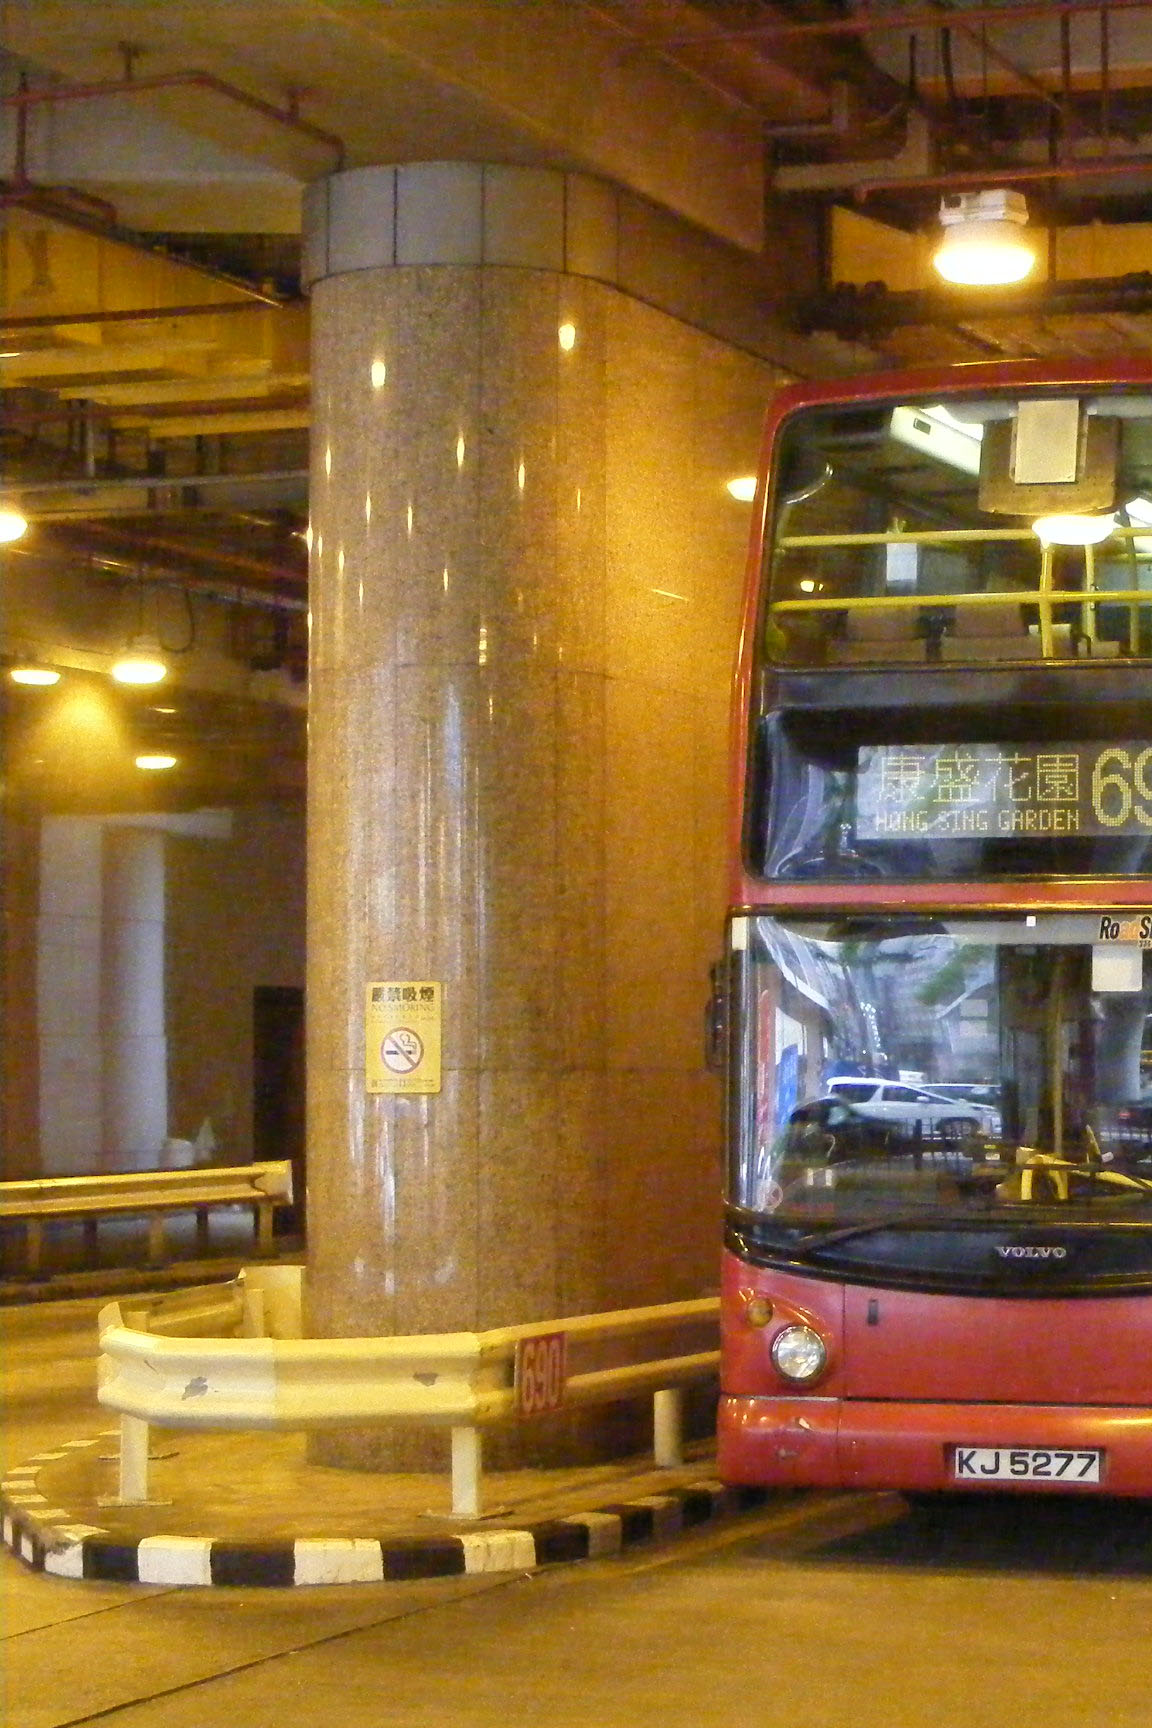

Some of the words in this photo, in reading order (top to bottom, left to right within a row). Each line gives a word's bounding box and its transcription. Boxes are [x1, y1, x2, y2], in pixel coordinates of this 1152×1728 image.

[879, 752, 1080, 803] 康盛花園
[875, 810, 929, 832] HONG
[940, 810, 988, 832] SING
[998, 809, 1080, 831] GARDEN
[995, 1246, 1067, 1259] VOLVO
[521, 1339, 561, 1414] 690
[957, 1450, 1000, 1475] KJ
[1009, 1452, 1097, 1478] 5277
